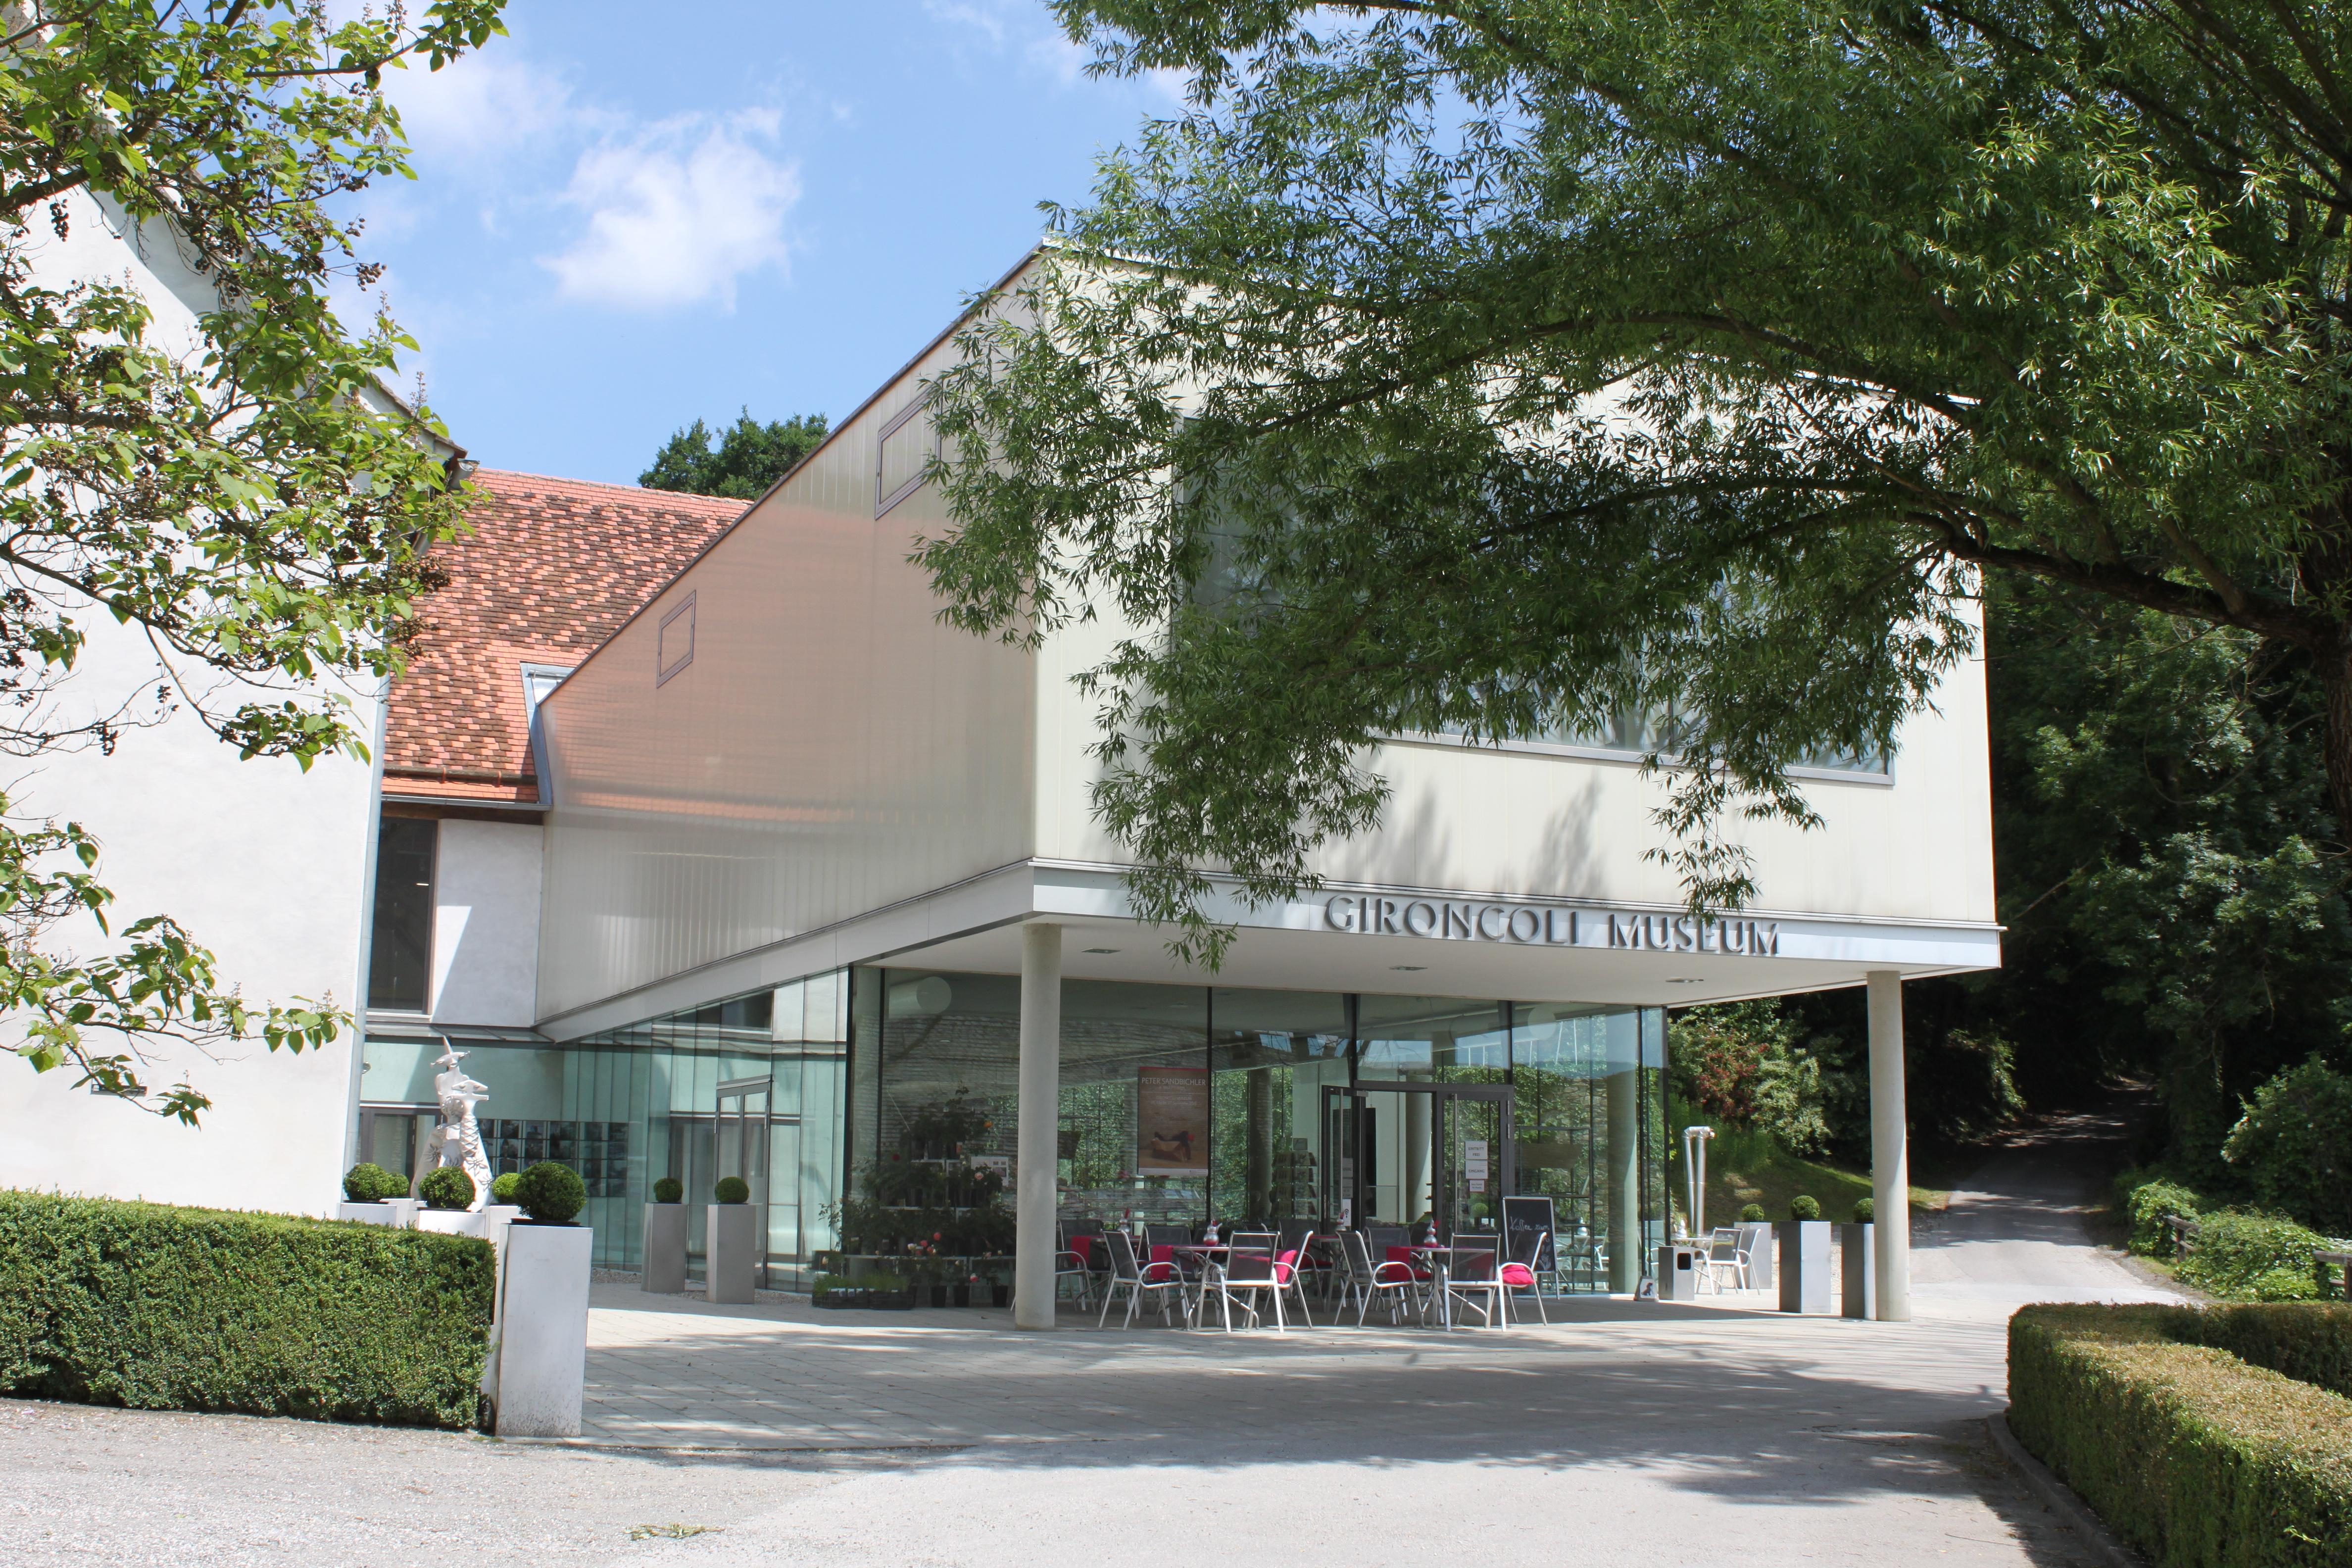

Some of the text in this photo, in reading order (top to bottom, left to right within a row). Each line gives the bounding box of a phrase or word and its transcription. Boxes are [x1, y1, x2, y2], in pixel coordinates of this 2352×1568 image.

[1325, 894, 1780, 955] GIRONCOLI MUSEUM
[1510, 1216, 1532, 1231] Kaffee
